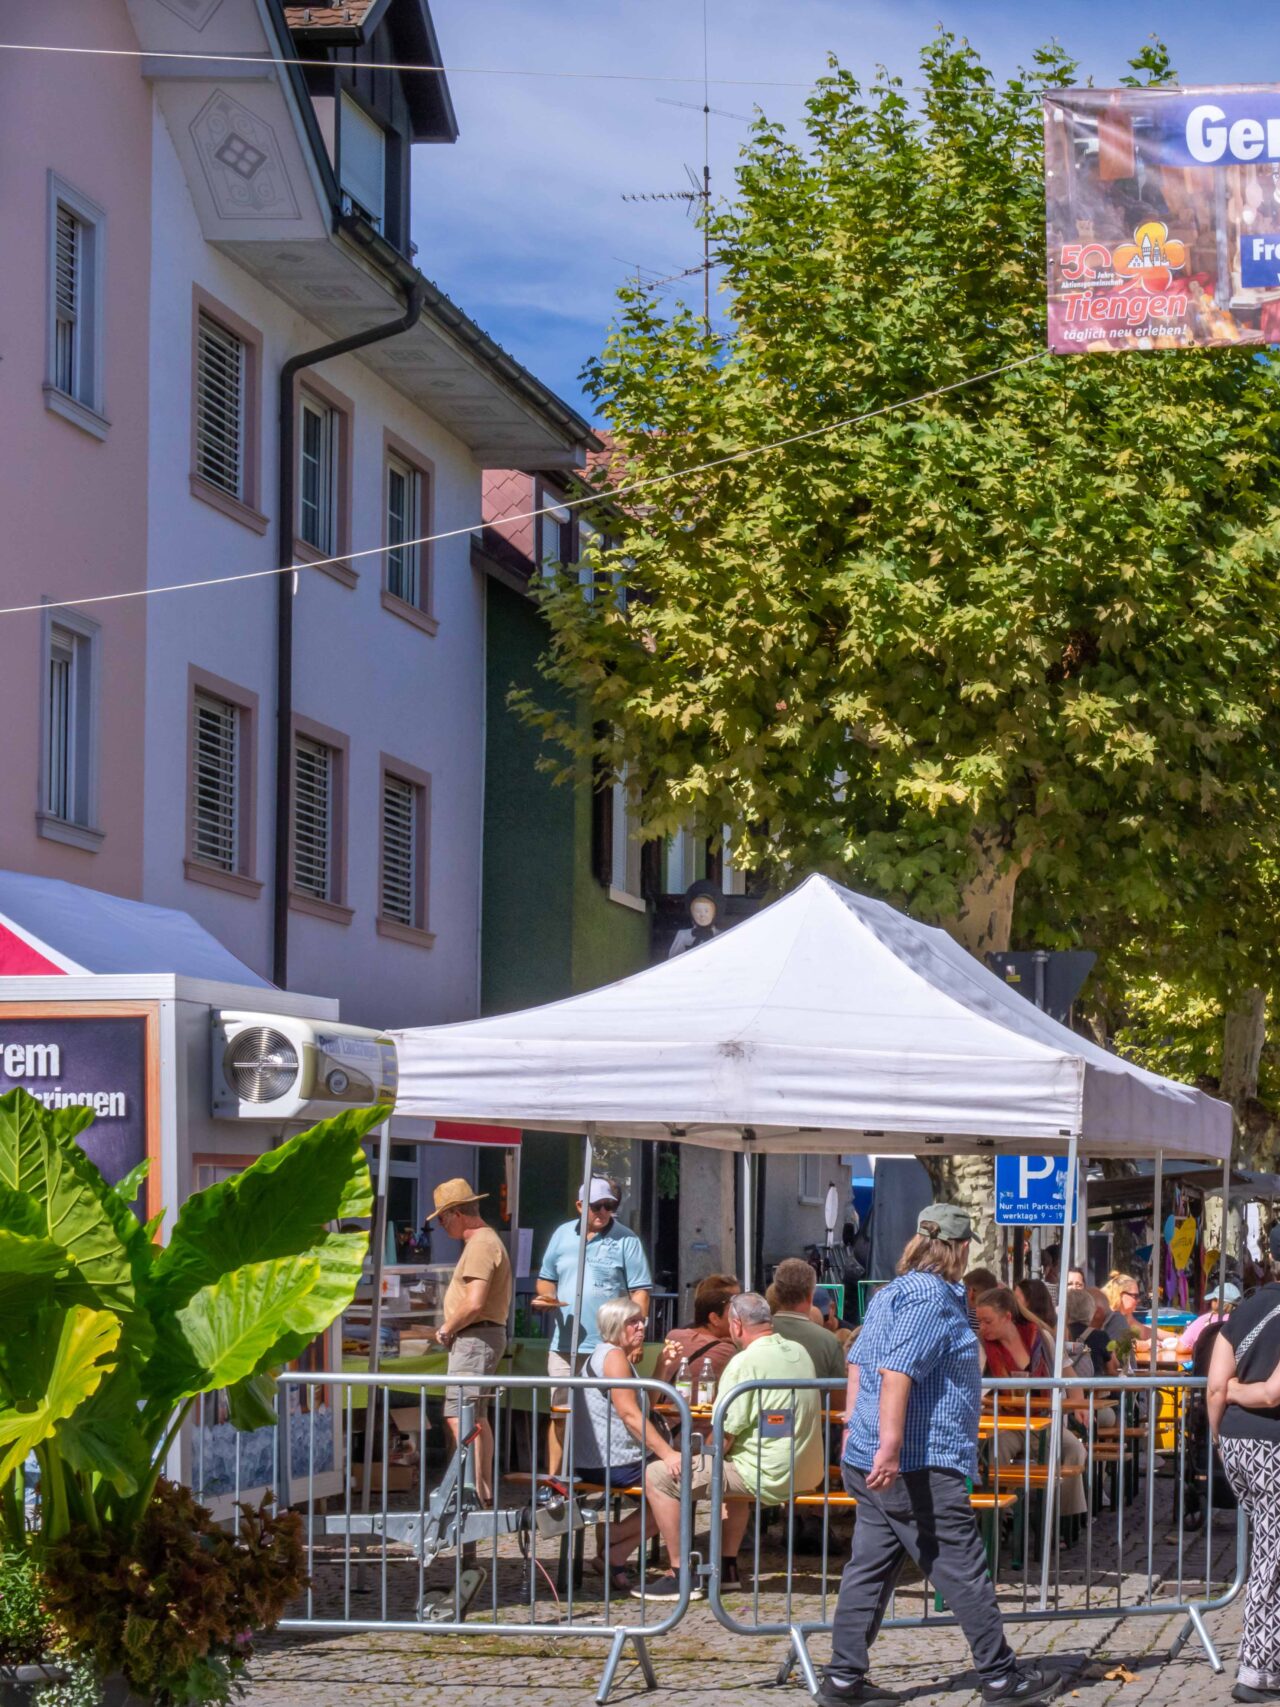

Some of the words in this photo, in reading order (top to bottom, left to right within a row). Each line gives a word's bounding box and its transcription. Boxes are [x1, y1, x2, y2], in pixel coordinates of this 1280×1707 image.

[1060, 243, 1112, 280] 50
[1061, 278, 1125, 289] Aktionsgemeinschaft
[1097, 271, 1116, 280] Jahre
[1061, 290, 1188, 326] Tiengen
[1063, 328, 1106, 342] täglich
[1109, 328, 1133, 338] neu
[1135, 323, 1188, 336] erleben!
[0, 1043, 60, 1077] em
[1019, 1155, 1055, 1199] P
[999, 1202, 1014, 1210] Nur
[1017, 1202, 1029, 1210] mit
[1003, 1212, 1038, 1221] werktags
